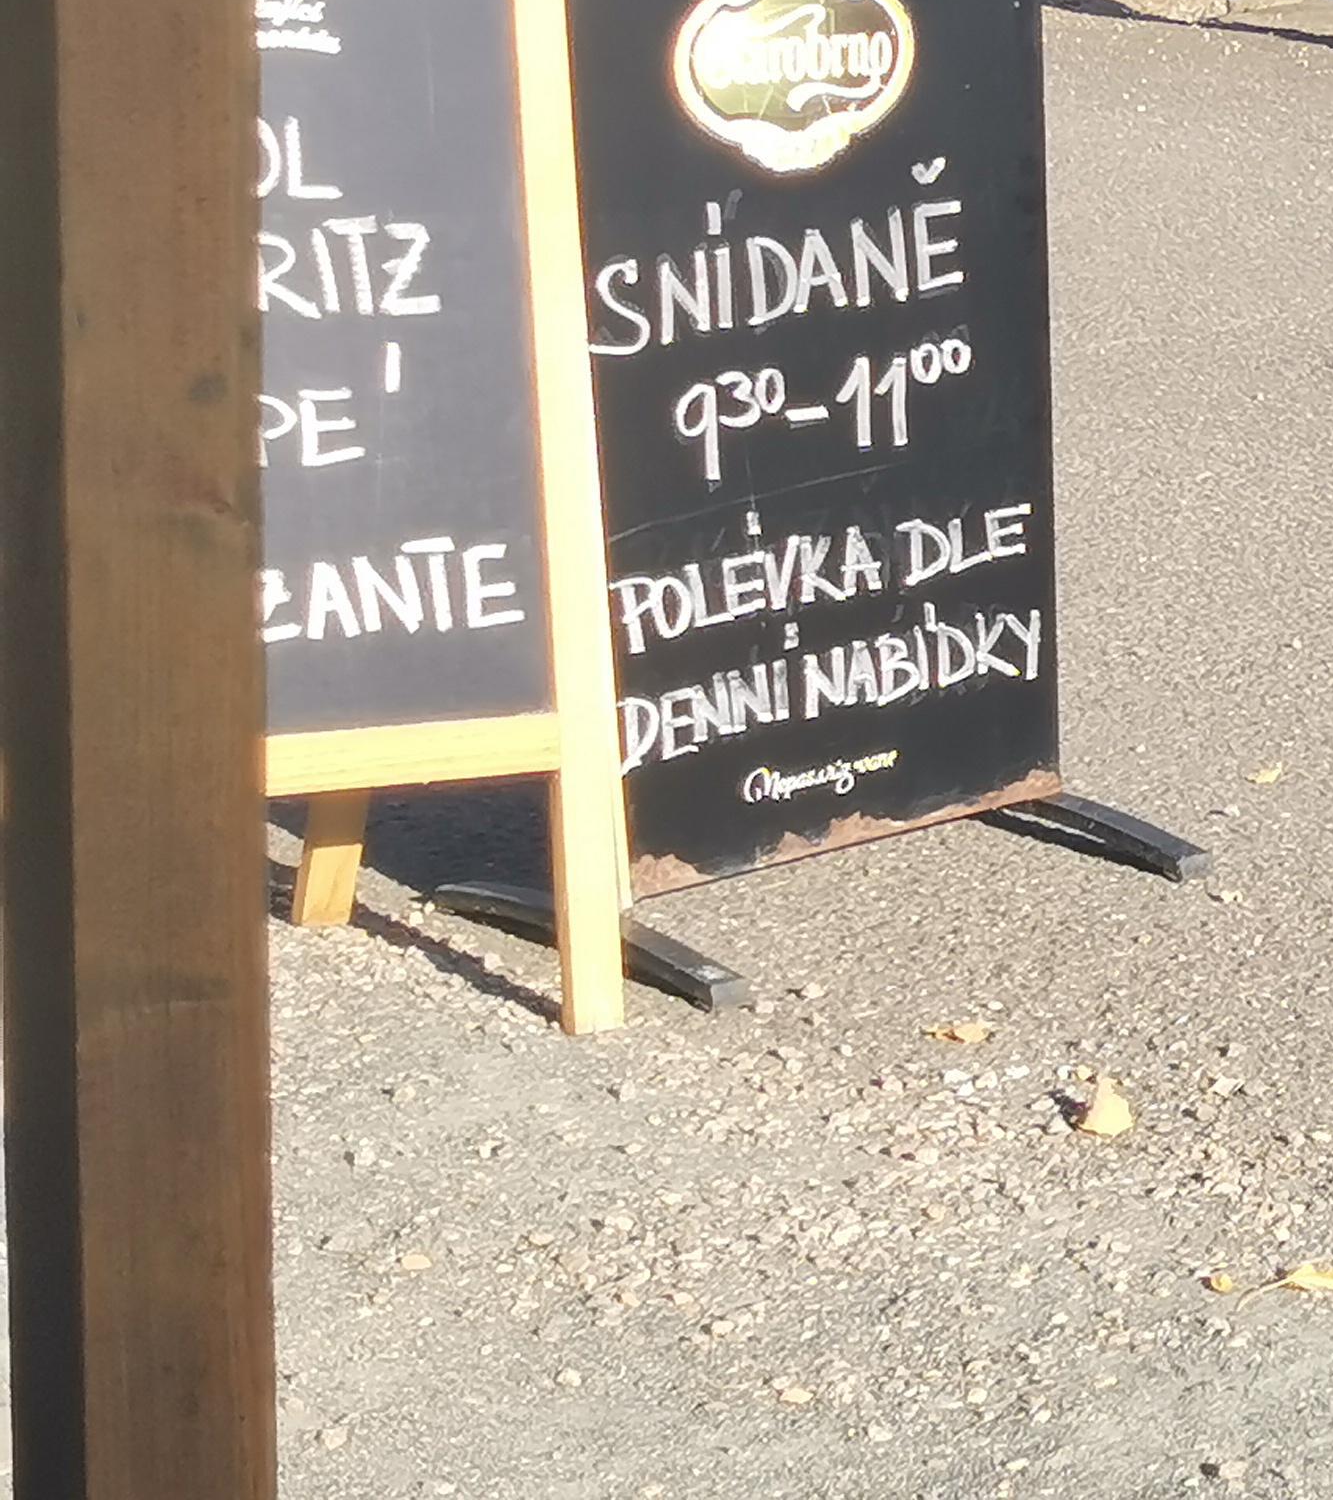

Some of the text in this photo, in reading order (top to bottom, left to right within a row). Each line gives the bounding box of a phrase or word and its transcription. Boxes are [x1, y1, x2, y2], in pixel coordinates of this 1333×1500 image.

[258, 215, 441, 319] RITZ
[588, 158, 965, 354] SNÍDANĚ
[609, 503, 1031, 655] POLÉVKA DLE
[616, 602, 1041, 777] DENNÍ NABÍDKY
